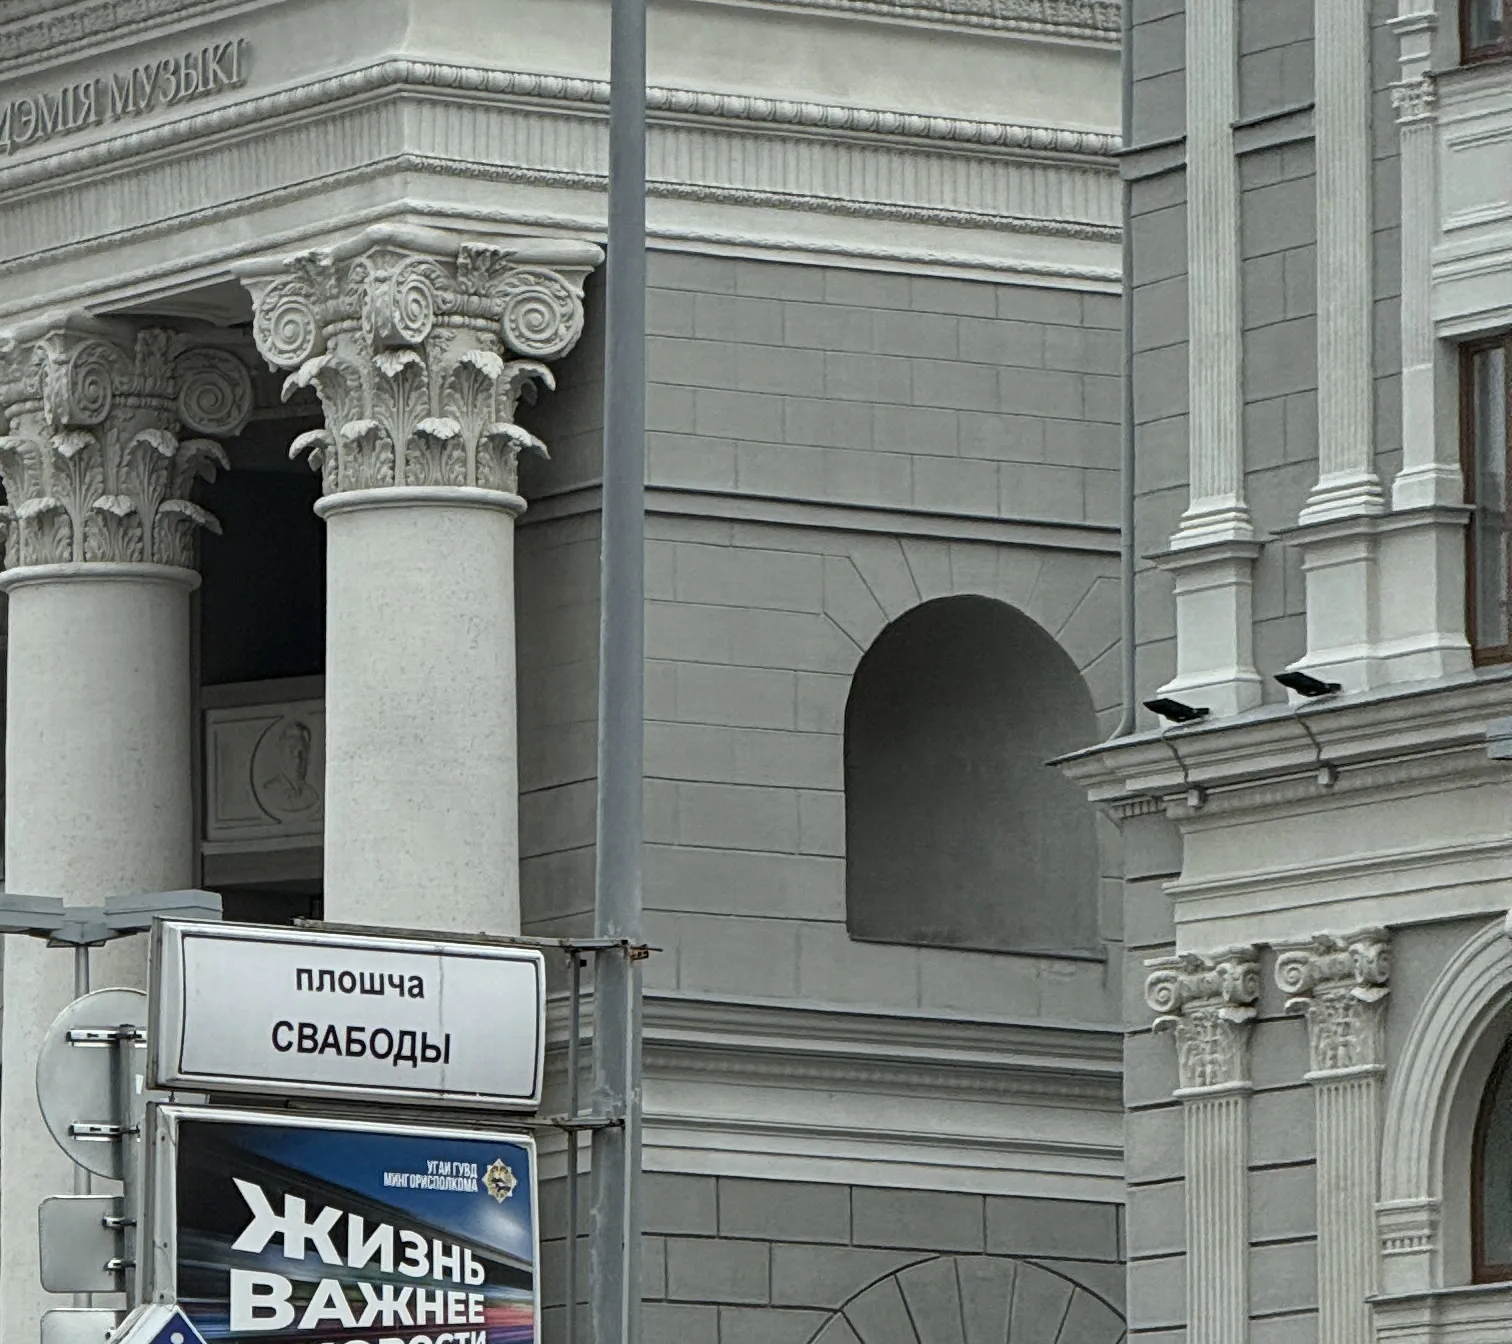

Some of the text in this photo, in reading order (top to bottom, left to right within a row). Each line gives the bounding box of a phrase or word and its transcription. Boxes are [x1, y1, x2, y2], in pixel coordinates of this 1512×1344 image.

[107, 40, 246, 115] МУЗЫКІ
[296, 968, 425, 999] плошча
[271, 1021, 451, 1068] СВАБОДЫ
[383, 1172, 478, 1192] МИНГОРИСПОЛКОМА
[453, 1162, 478, 1177] ГУВД
[231, 1177, 485, 1286] ЖИЗНЬ
[230, 1269, 485, 1332] ВАЖНЕЕ
